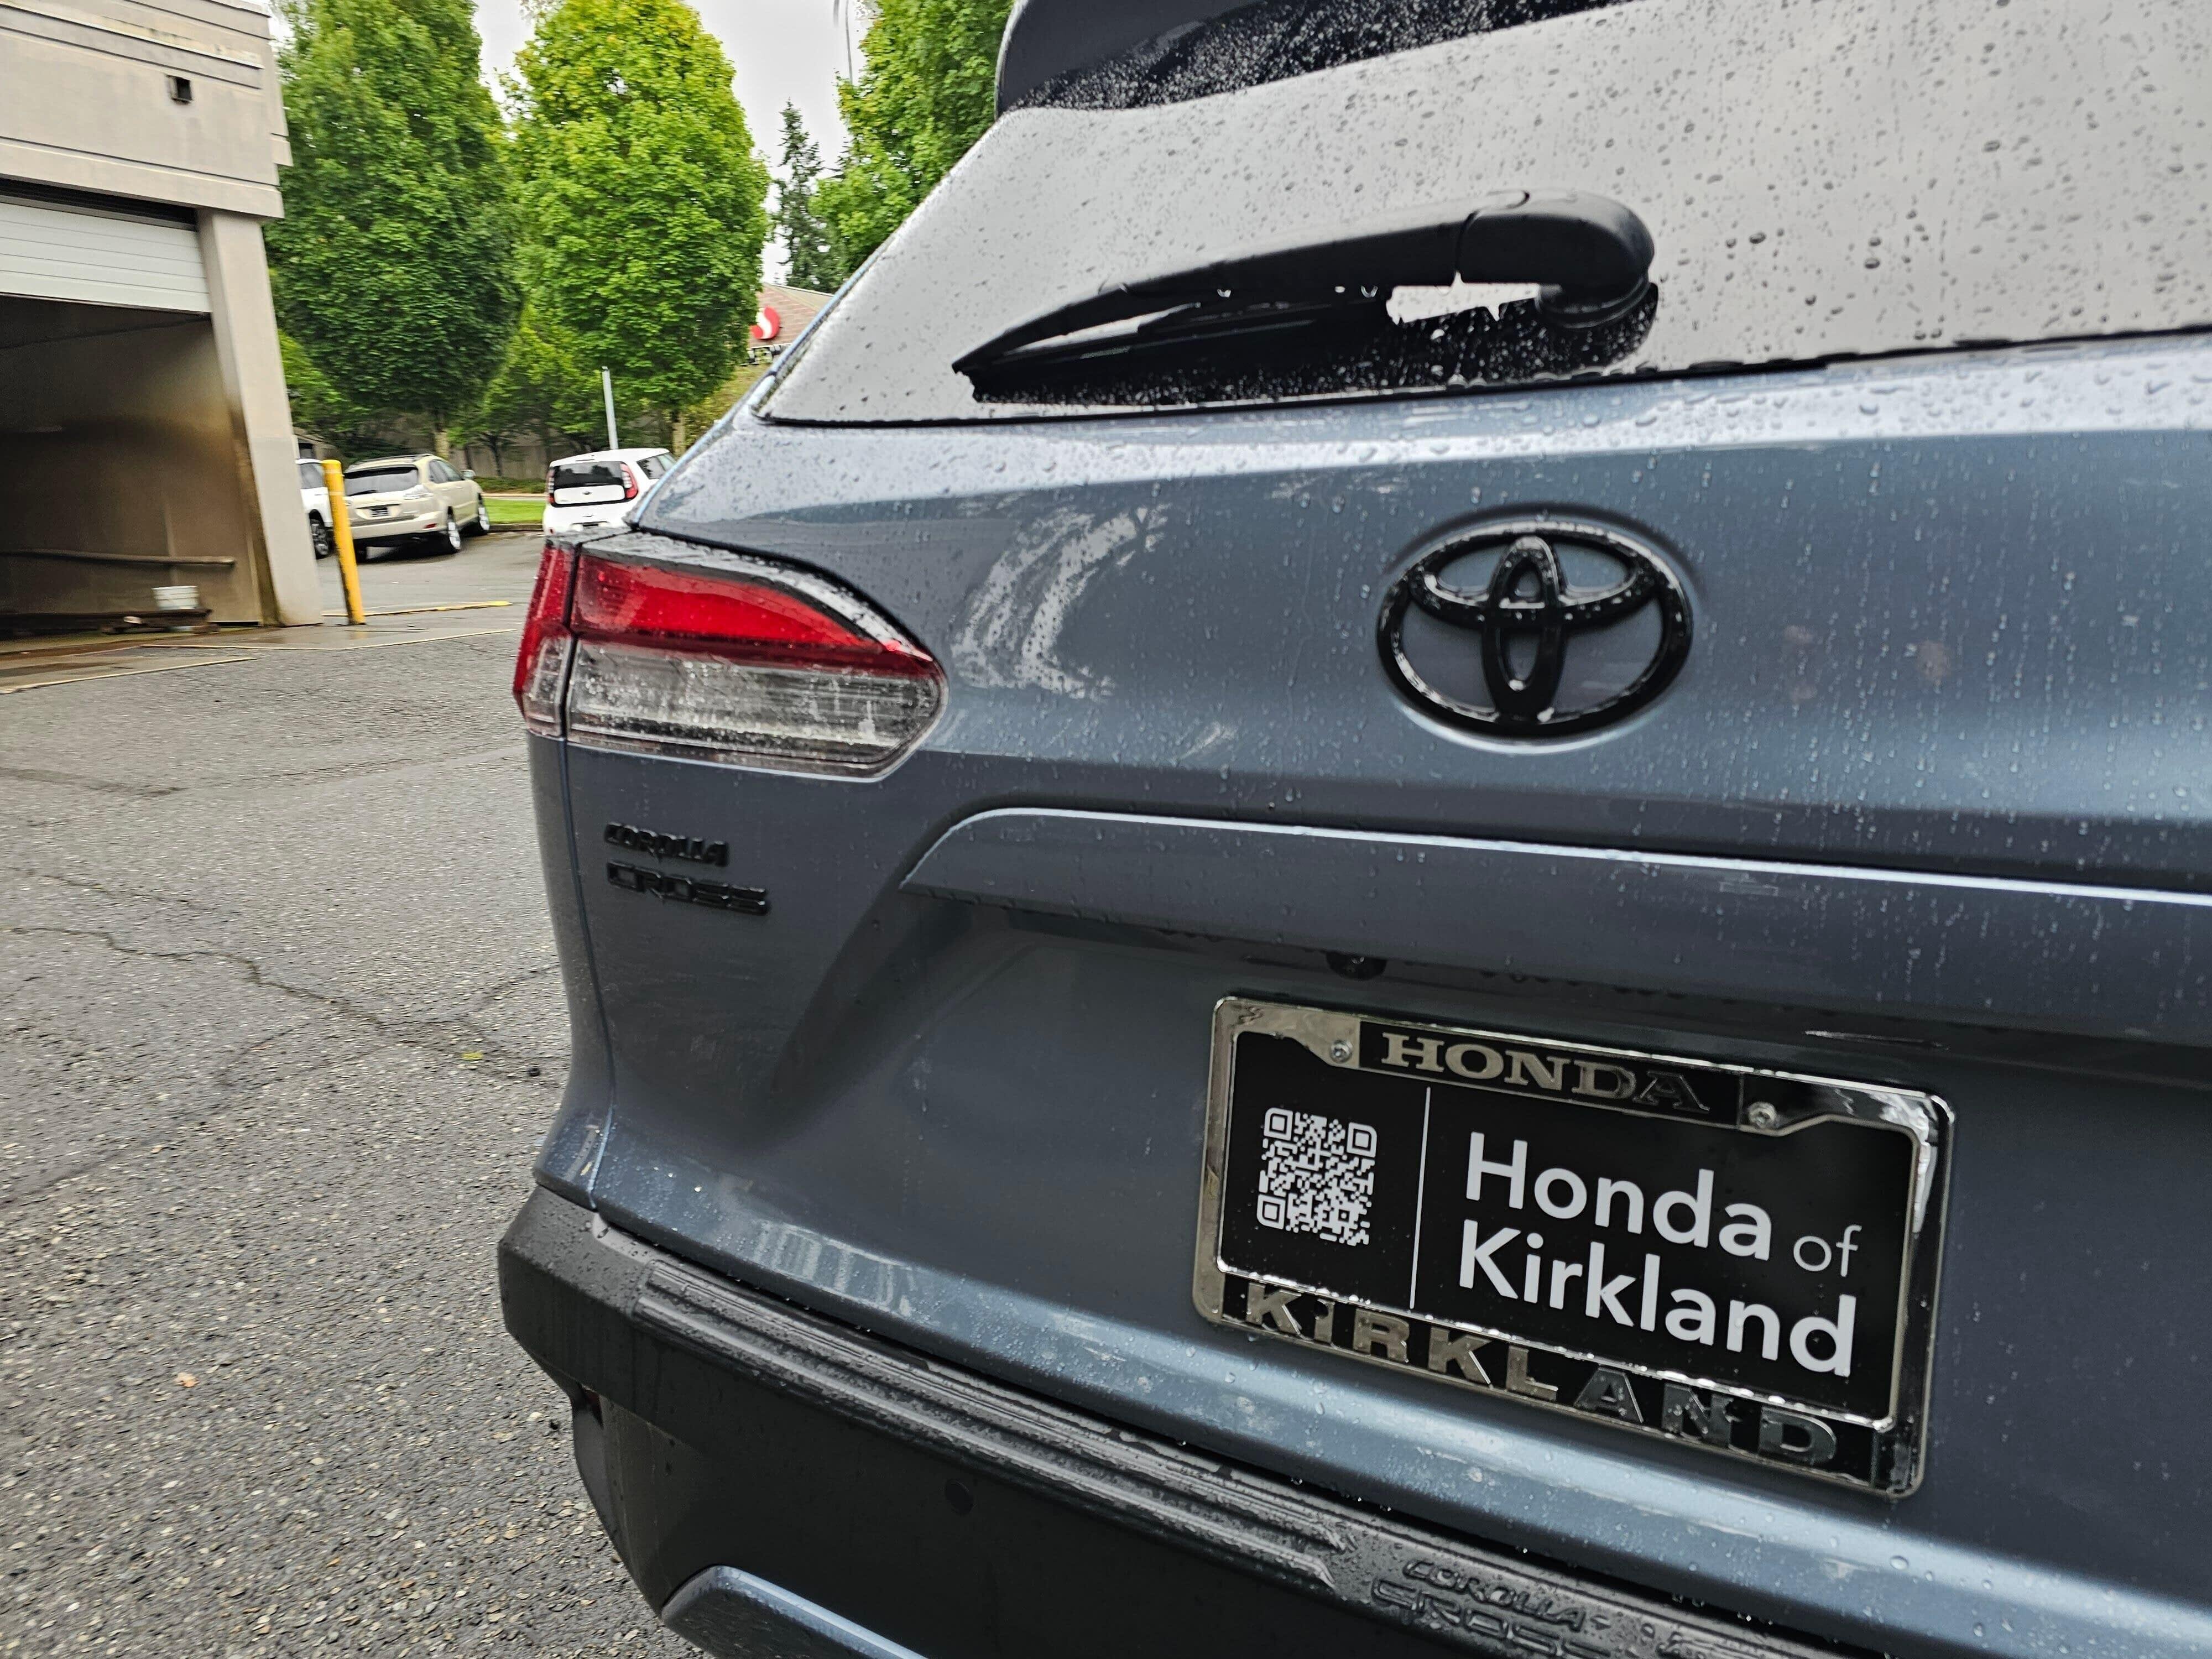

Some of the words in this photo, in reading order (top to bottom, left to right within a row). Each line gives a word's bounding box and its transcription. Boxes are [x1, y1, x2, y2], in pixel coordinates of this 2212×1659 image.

[607, 860, 769, 915] CROSS
[1381, 1032, 1711, 1113] HONDA
[1465, 1131, 1772, 1261] Honda
[1793, 1224, 1863, 1278] of
[1459, 1219, 1857, 1378] Kirkland
[1246, 1282, 1837, 1465] KIRKLAND
